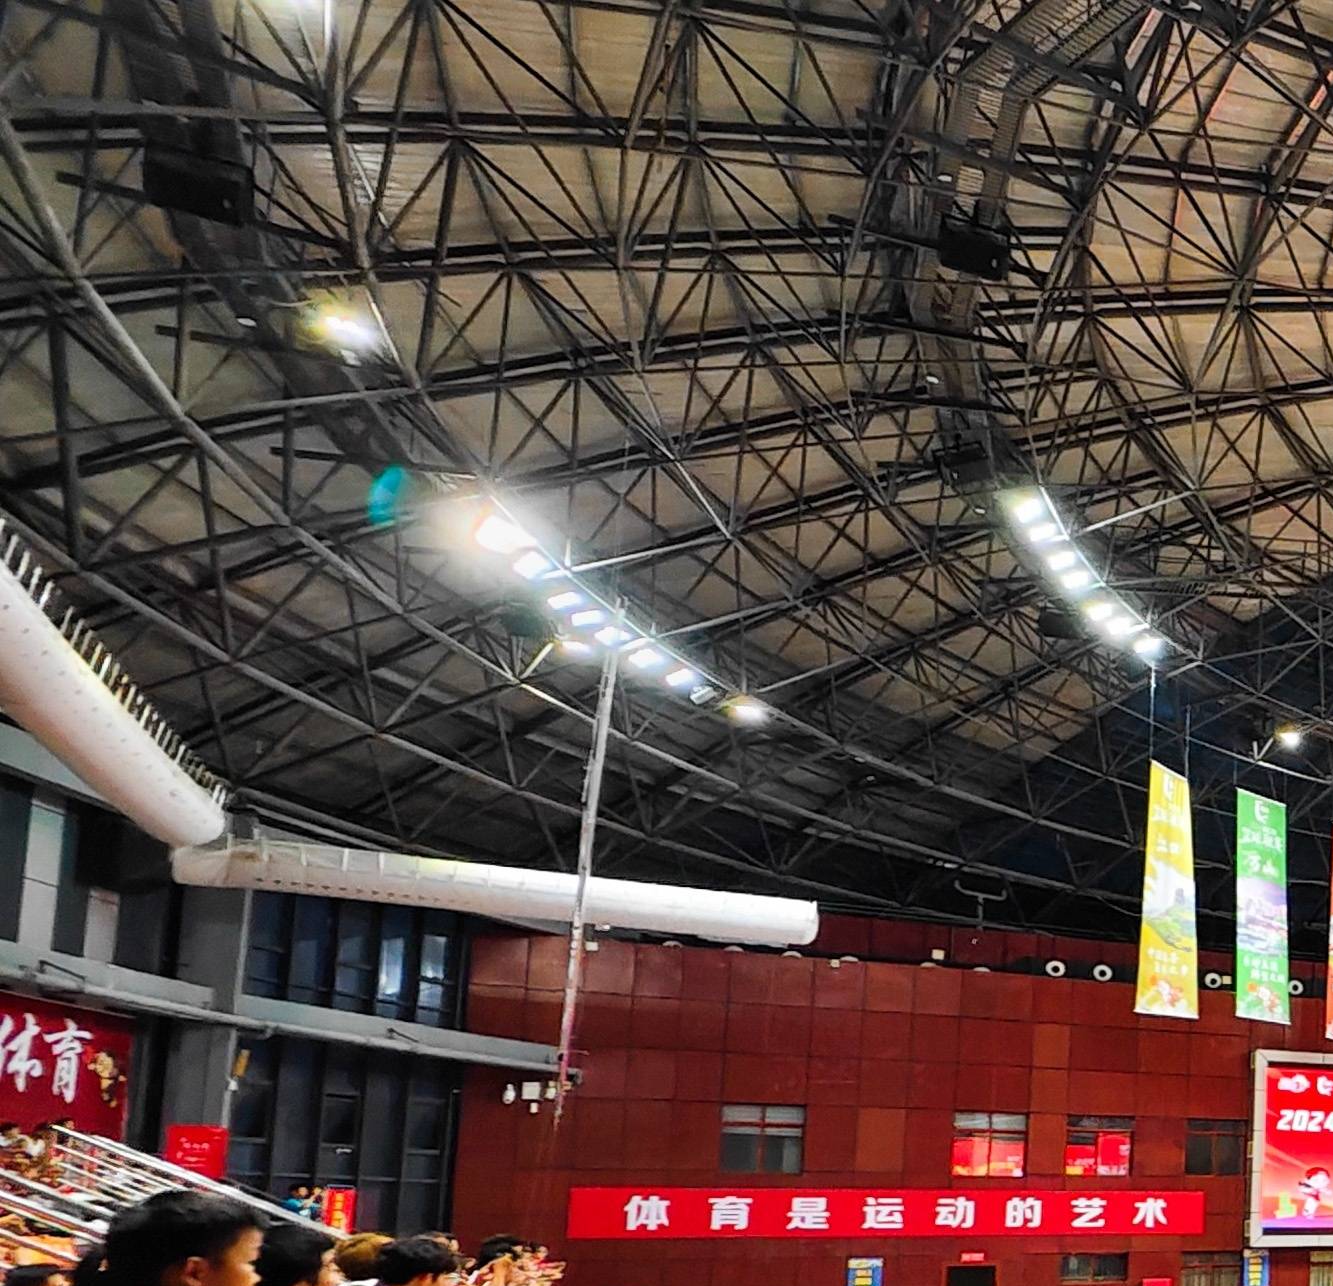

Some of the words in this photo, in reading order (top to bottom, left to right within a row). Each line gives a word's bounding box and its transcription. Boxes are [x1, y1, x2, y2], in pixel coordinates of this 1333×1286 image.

[622, 1193, 1169, 1232] 体育是运动的艺术
